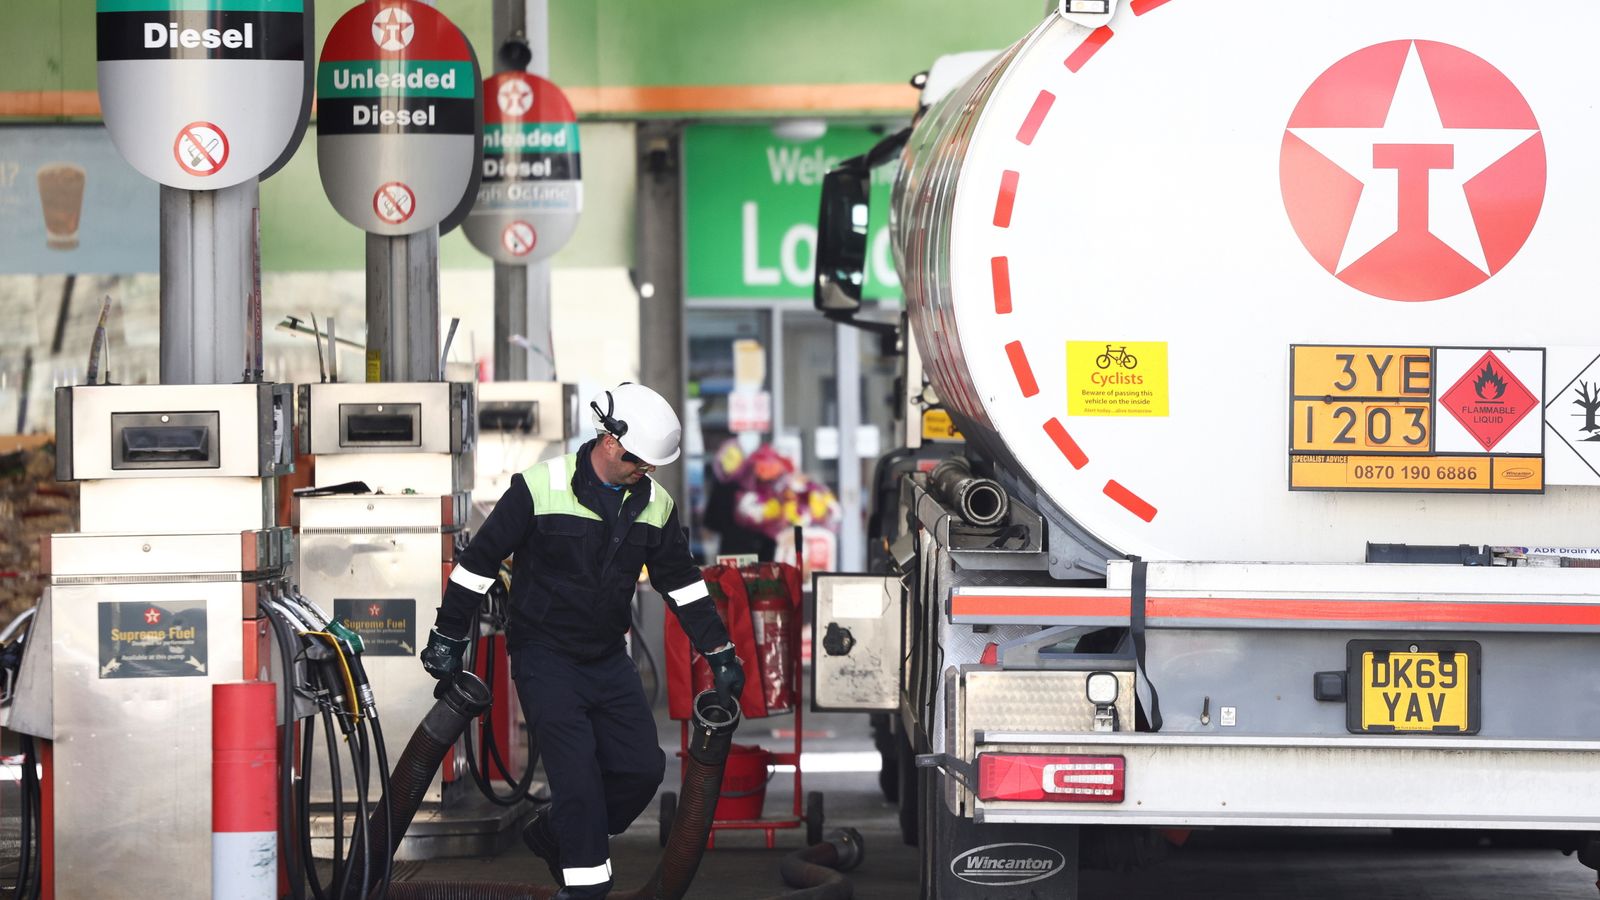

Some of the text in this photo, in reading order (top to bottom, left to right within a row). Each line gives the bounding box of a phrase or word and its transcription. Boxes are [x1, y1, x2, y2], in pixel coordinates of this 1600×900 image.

[144, 22, 253, 49] Diesel
[333, 68, 456, 90] Unleaded
[353, 105, 435, 126] Diesel
[483, 127, 567, 148] nleaded
[483, 157, 552, 177] Diesel
[1091, 372, 1144, 387] Cyclists
[1334, 354, 1430, 393] 3YE
[1081, 389, 1106, 397] Beware
[1107, 389, 1114, 397] of
[1115, 390, 1140, 399] passing
[1085, 397, 1108, 405] vehicle
[1462, 406, 1516, 415] FLAMMABLE
[1306, 406, 1427, 445] 1203
[1473, 416, 1504, 424] LIQUID
[1486, 437, 1492, 445] 3
[1326, 456, 1347, 464] ADVICE
[1354, 465, 1477, 480] 0870 190 6886
[1559, 547, 1587, 555] Drain
[343, 619, 406, 631] Supreme Fuel
[111, 627, 195, 643] Supreme Fuel
[1371, 658, 1458, 689] DK69
[1382, 692, 1446, 722] YAV
[966, 856, 1053, 870] Wincanton
